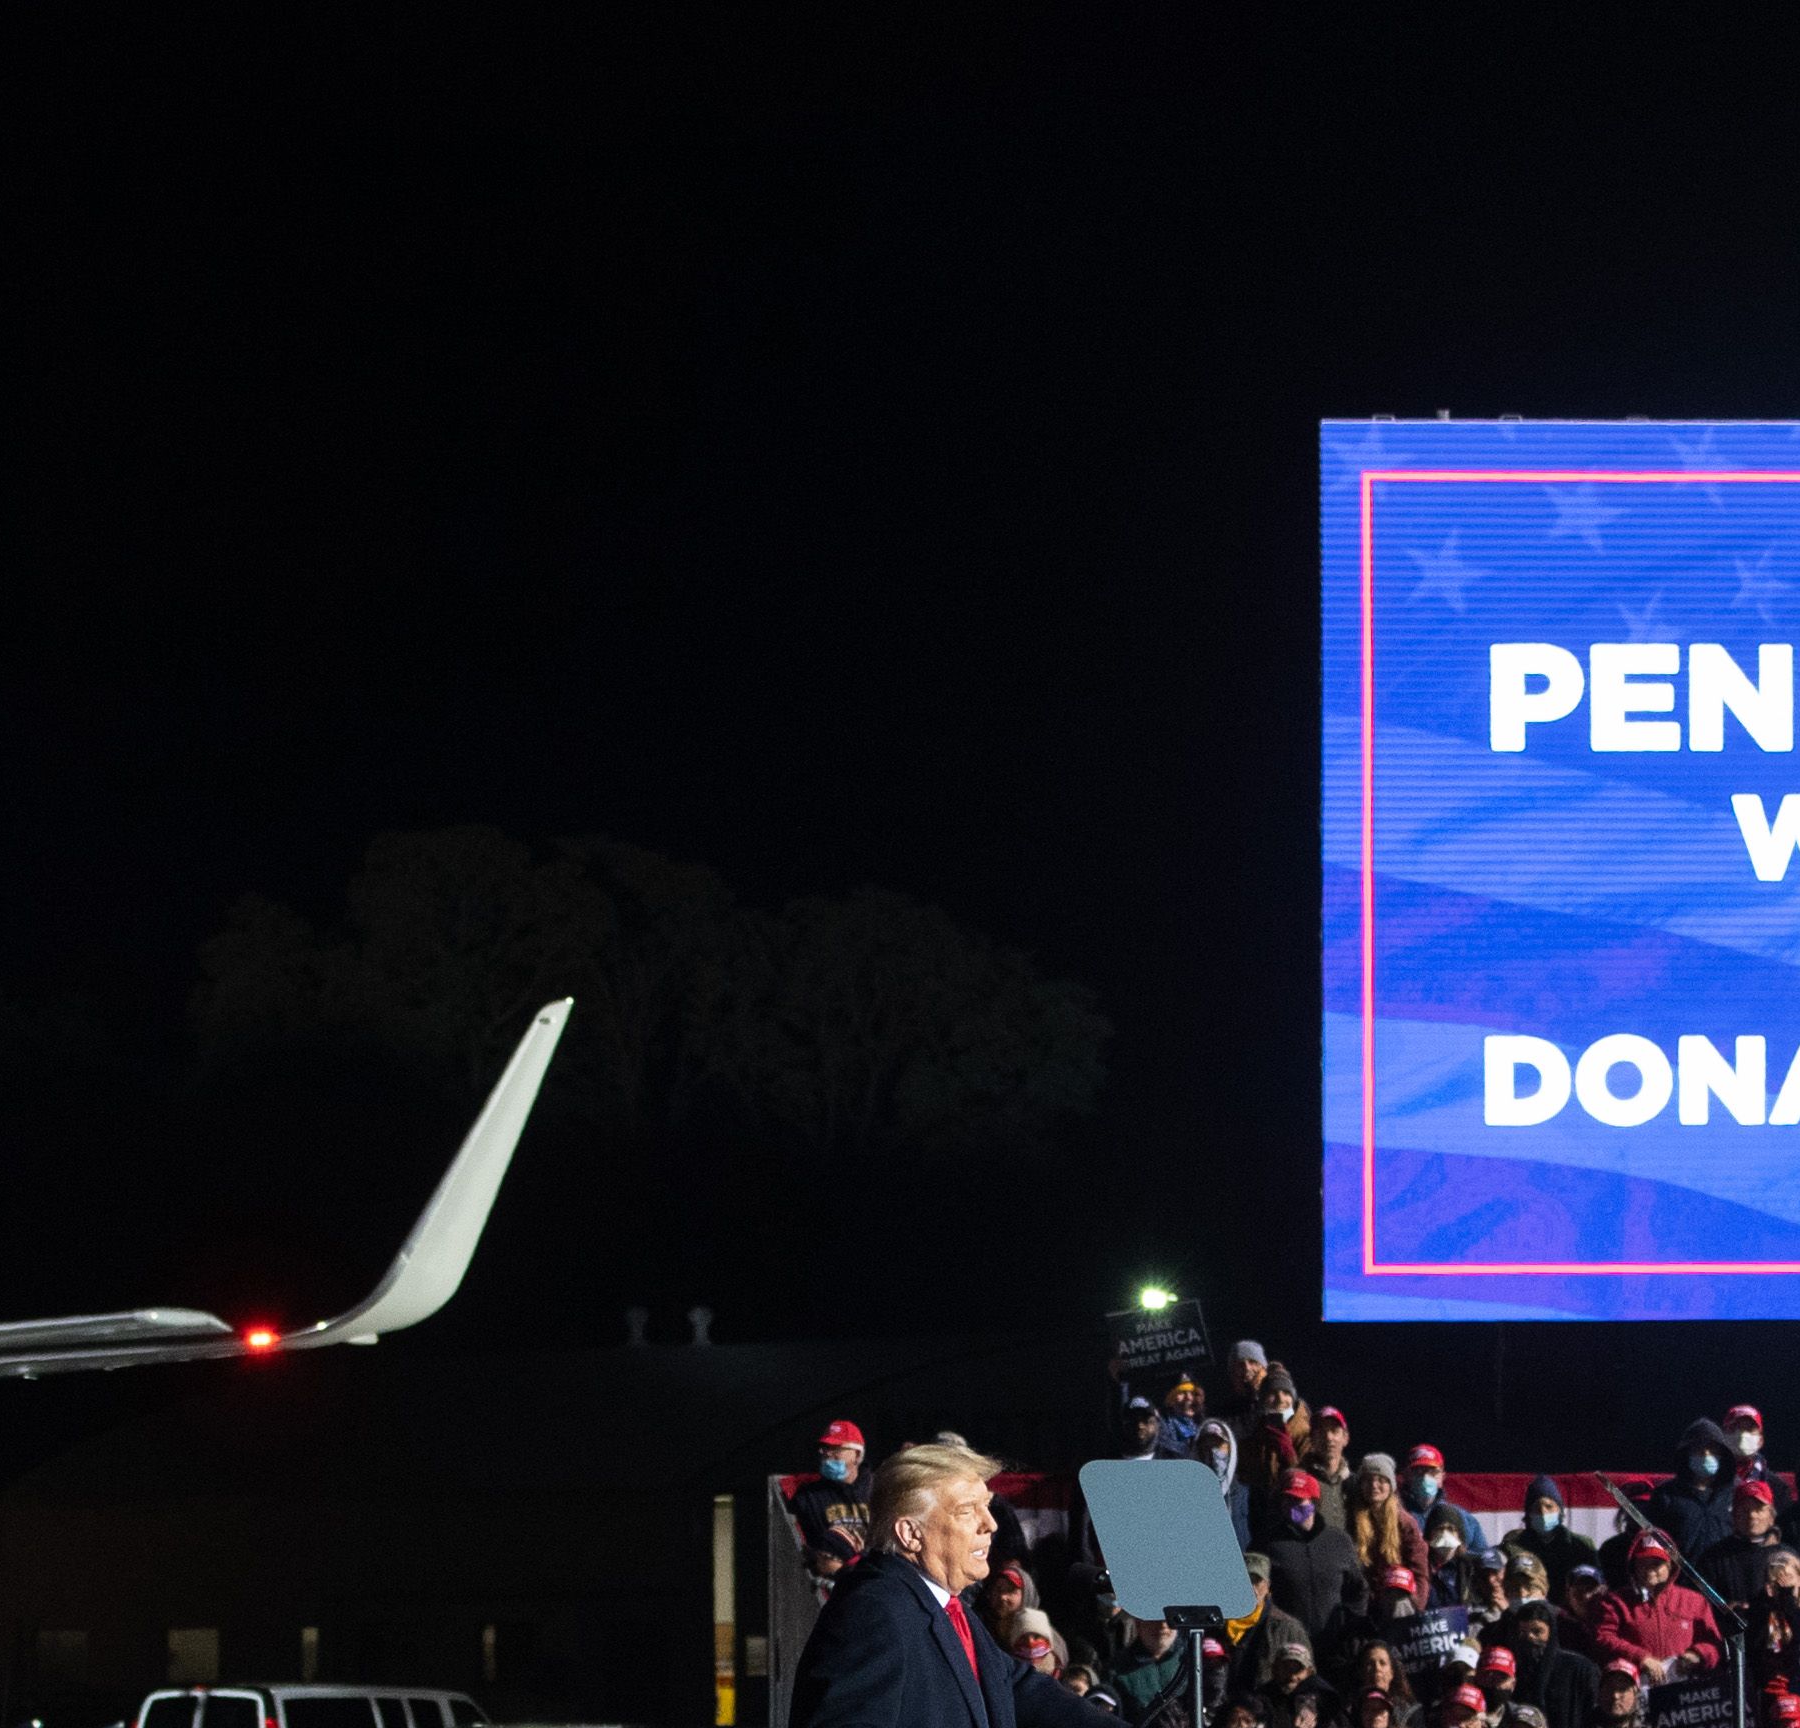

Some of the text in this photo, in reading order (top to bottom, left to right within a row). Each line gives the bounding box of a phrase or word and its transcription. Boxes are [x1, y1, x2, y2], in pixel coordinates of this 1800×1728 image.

[1119, 1328, 1201, 1354] AMERICA
[1127, 1354, 1161, 1368] REAT
[1410, 1618, 1450, 1637] MAKE
[1391, 1632, 1466, 1659] AMERIC
[1678, 1687, 1722, 1706] MAKE
